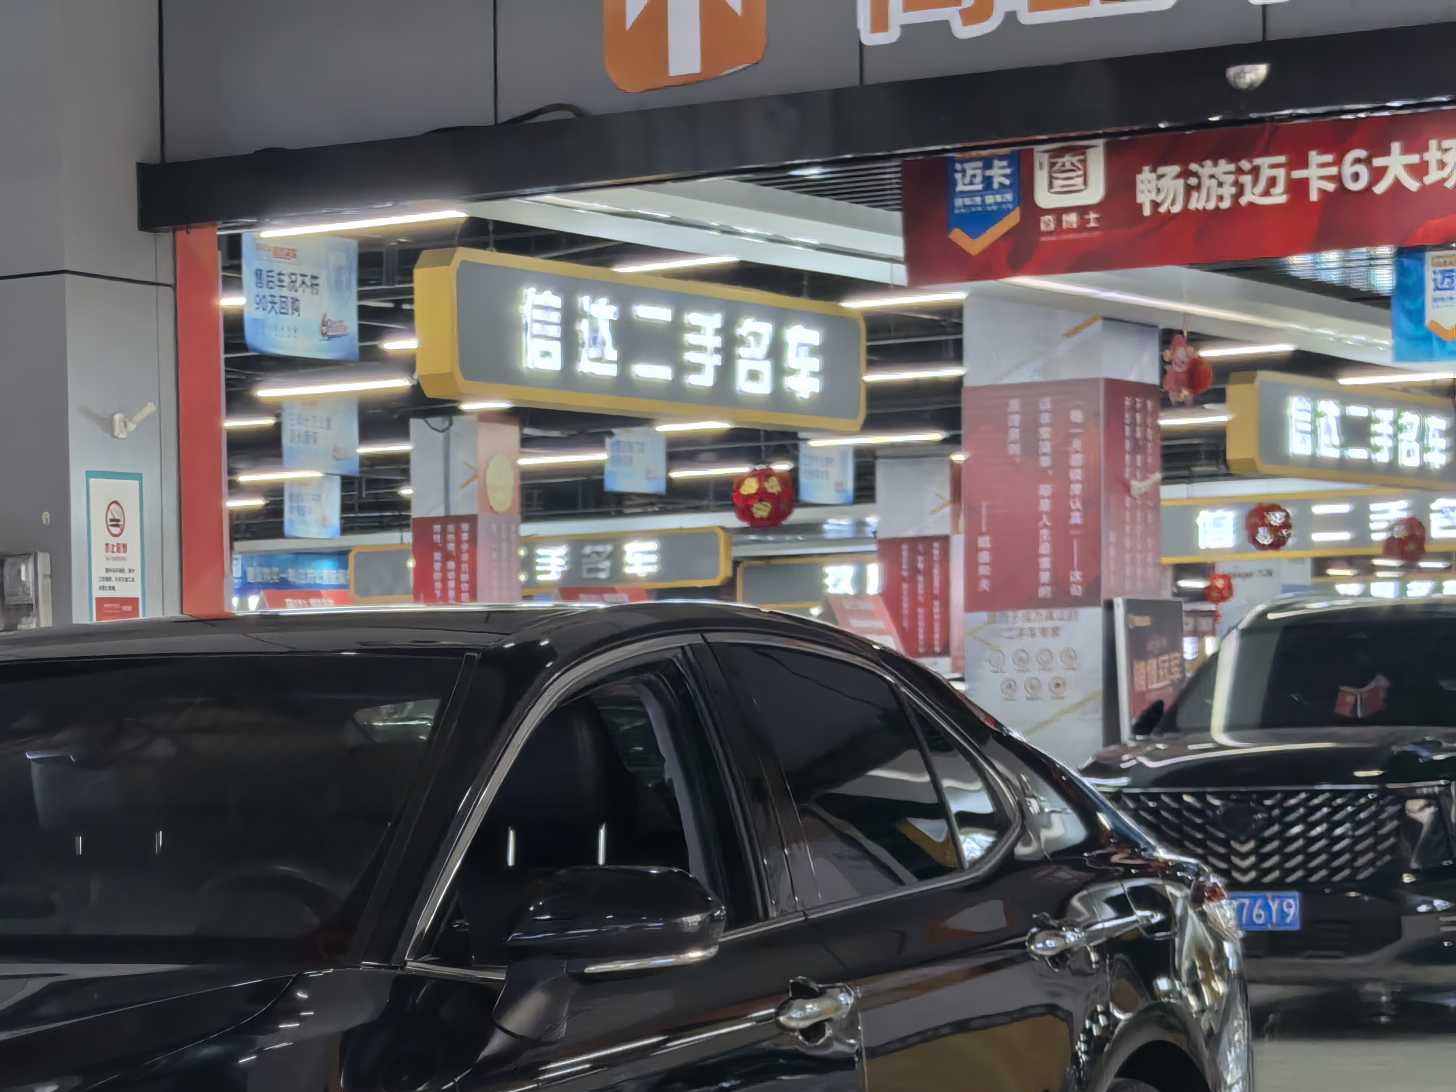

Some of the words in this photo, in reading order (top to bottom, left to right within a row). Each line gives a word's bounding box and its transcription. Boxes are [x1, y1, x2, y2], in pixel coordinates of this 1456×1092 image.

[954, 159, 1012, 192] 迈卡
[520, 286, 822, 399] 信达二手名车
[1286, 396, 1448, 470] 信达二手名车
